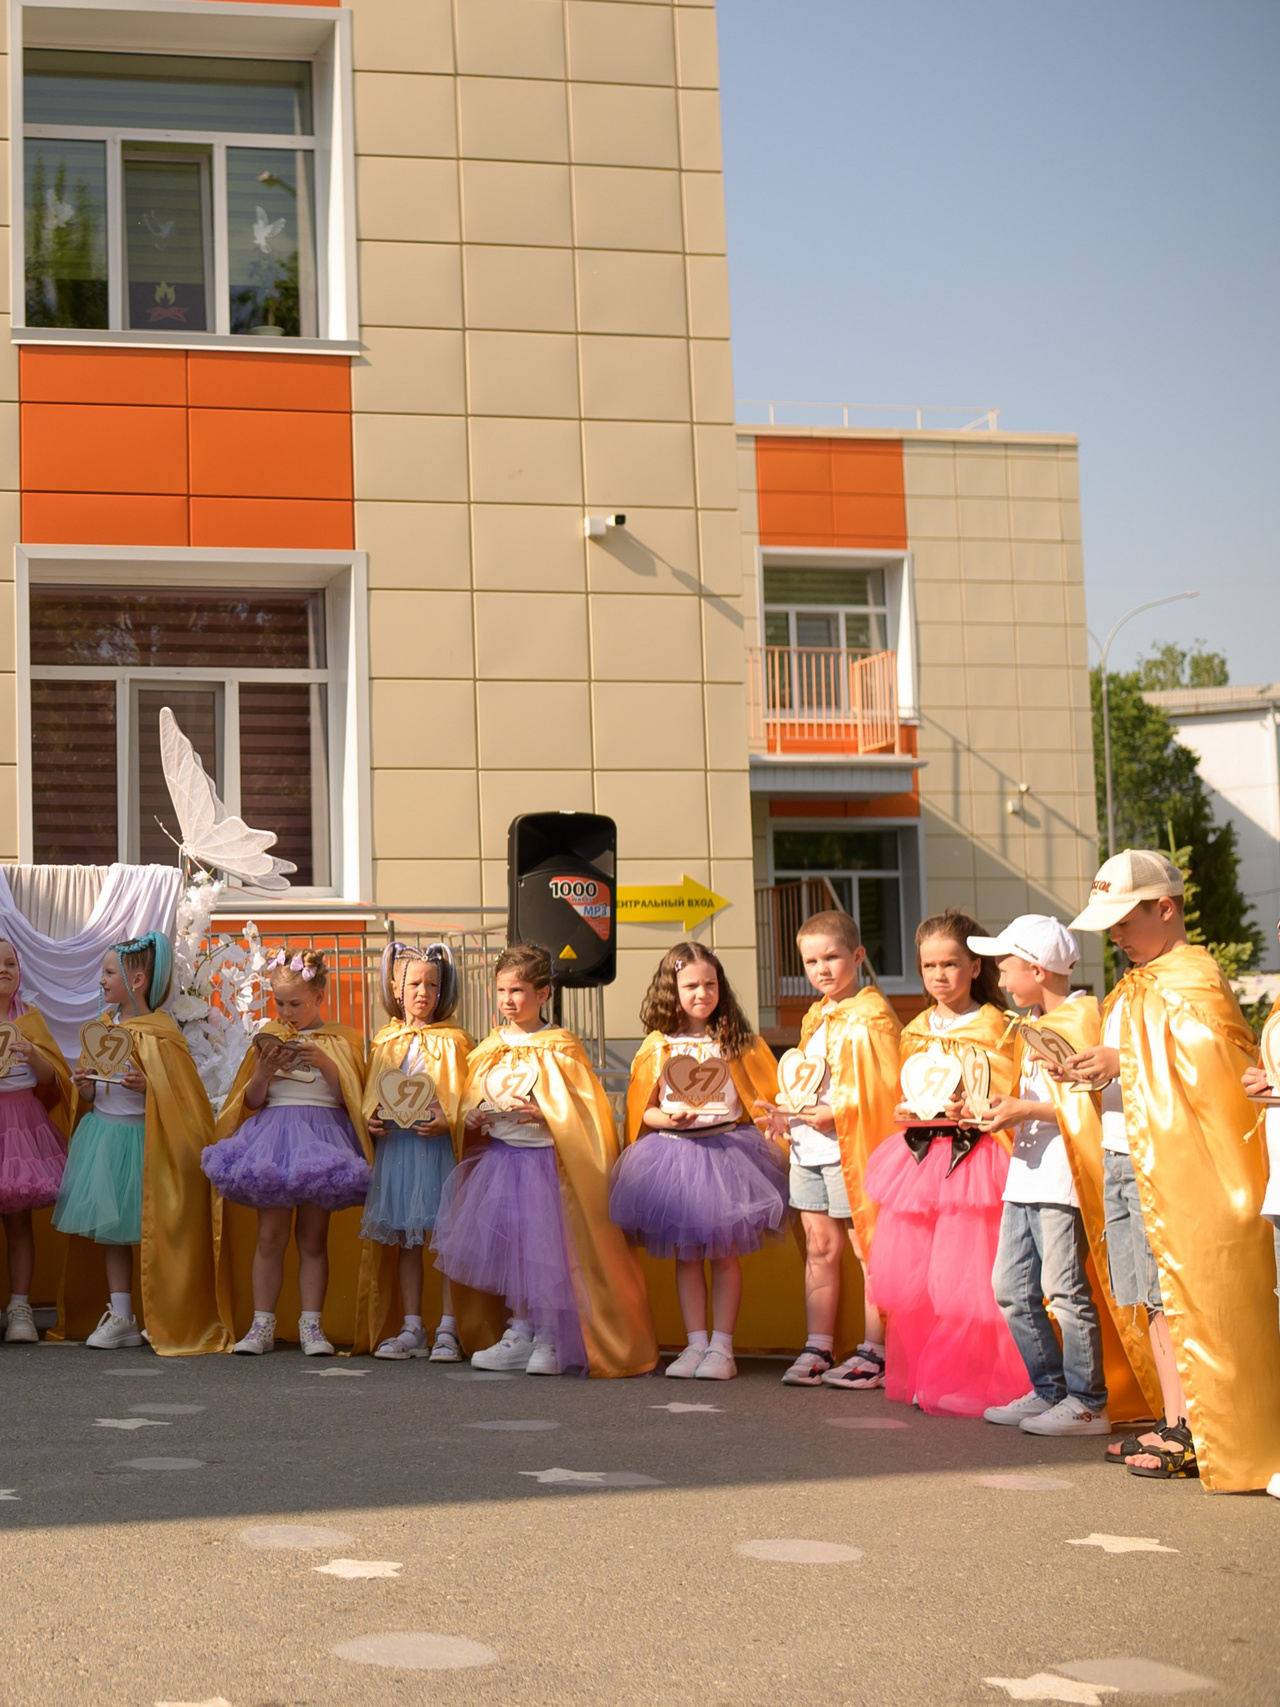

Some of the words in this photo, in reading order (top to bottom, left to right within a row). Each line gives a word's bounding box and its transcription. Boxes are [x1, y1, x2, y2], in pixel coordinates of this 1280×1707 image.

[550, 880, 598, 898] 1000
[617, 897, 684, 908] ЕНТРАЛЬНЫЙ
[687, 898, 714, 908] ВХОД
[584, 905, 607, 917] MP3
